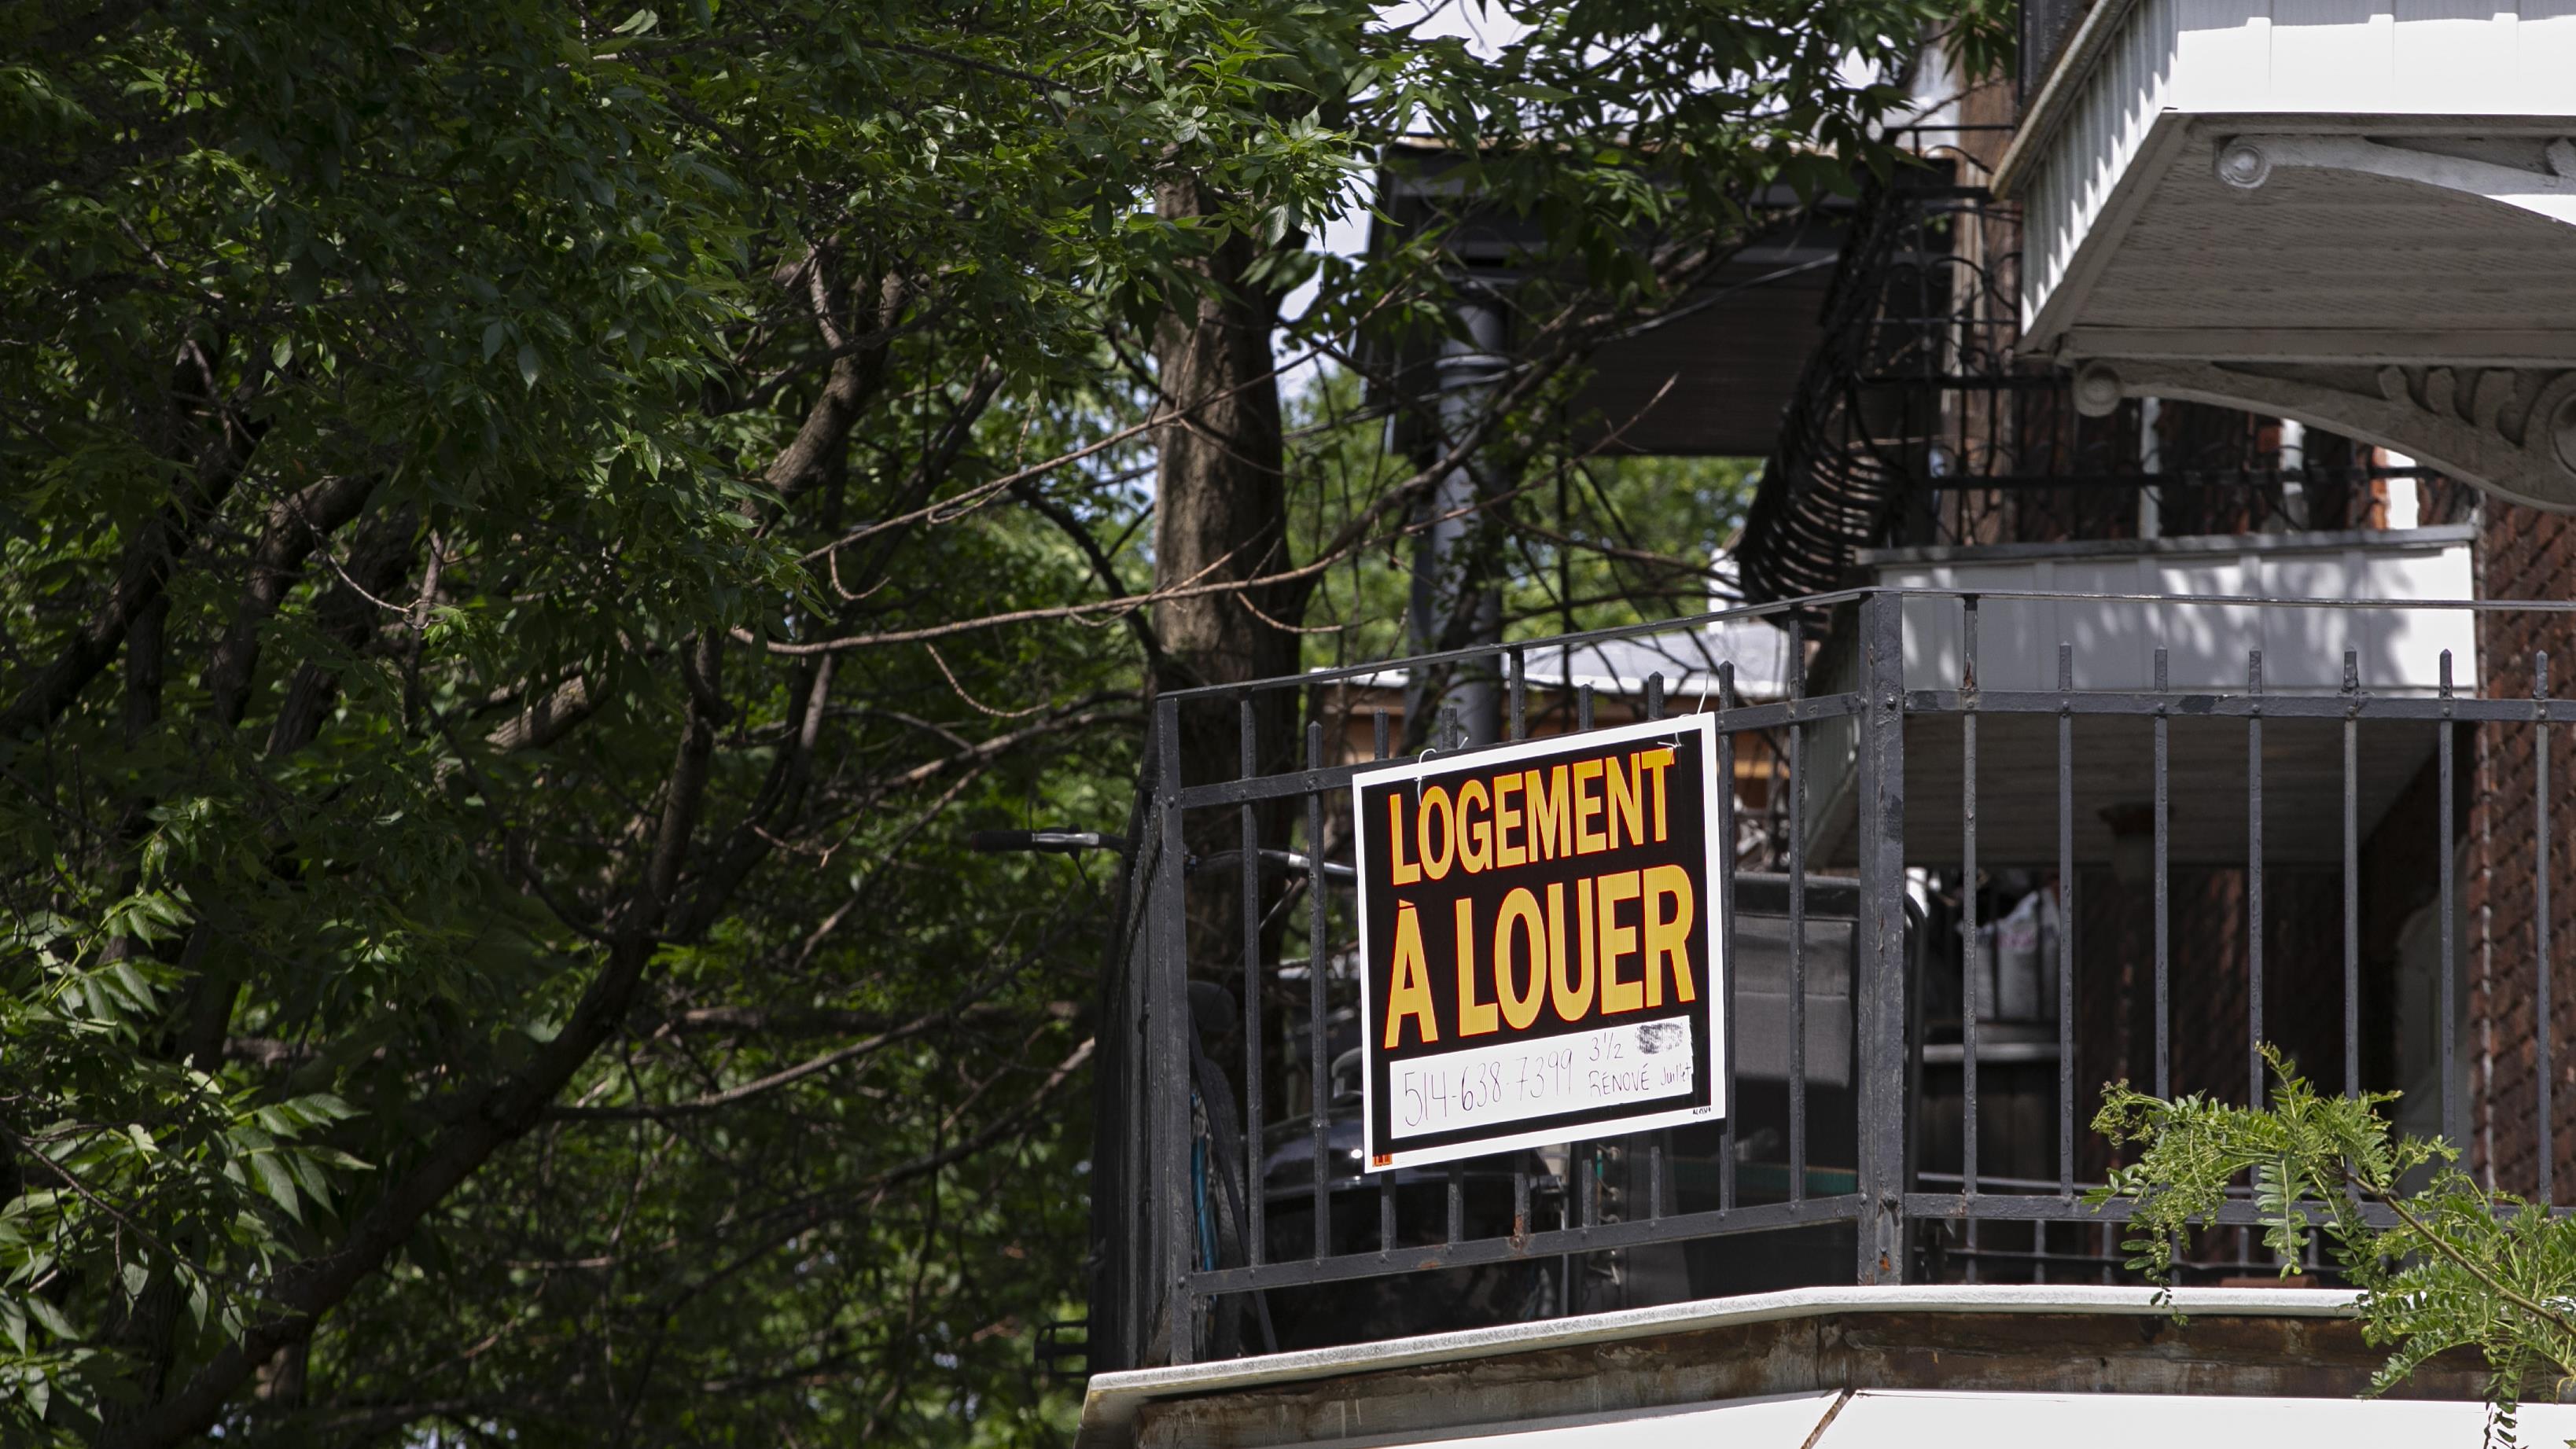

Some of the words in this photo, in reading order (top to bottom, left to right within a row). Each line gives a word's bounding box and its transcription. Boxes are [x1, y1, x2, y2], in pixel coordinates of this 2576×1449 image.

[1389, 747, 1675, 886] LOGEMENT
[1384, 899, 1439, 1049] À
[1455, 864, 1696, 1038] LOUER
[1588, 1062, 1650, 1098] RÉNOVÉ
